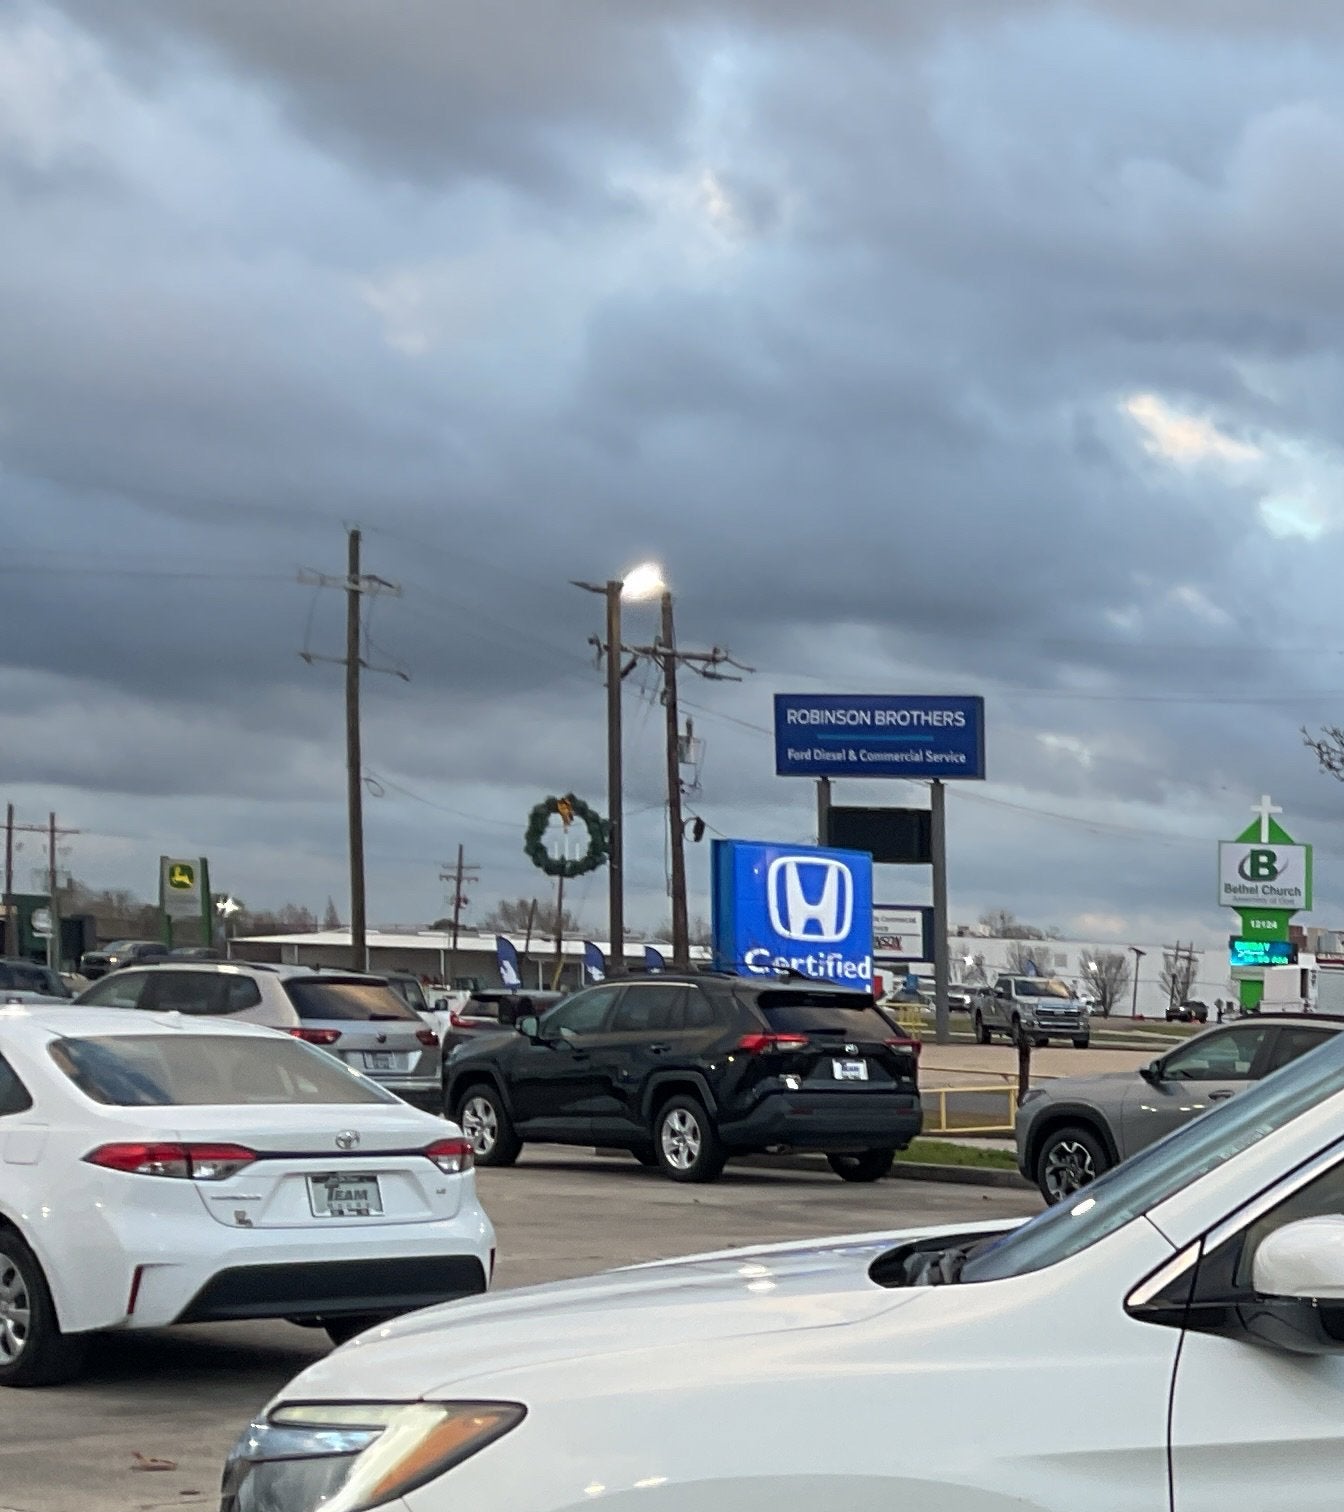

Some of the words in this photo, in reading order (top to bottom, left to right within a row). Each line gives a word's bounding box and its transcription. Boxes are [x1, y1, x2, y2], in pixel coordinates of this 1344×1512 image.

[787, 709, 870, 725] ROBINSON
[875, 710, 966, 727] BROTHERS
[788, 748, 811, 761] Ford
[814, 748, 846, 762] Diesel
[848, 750, 857, 762] &
[860, 749, 923, 763] Commercial
[926, 750, 966, 764] Service
[1224, 883, 1259, 894] Bethel
[1262, 885, 1301, 897] Church
[744, 948, 872, 979] Certified
